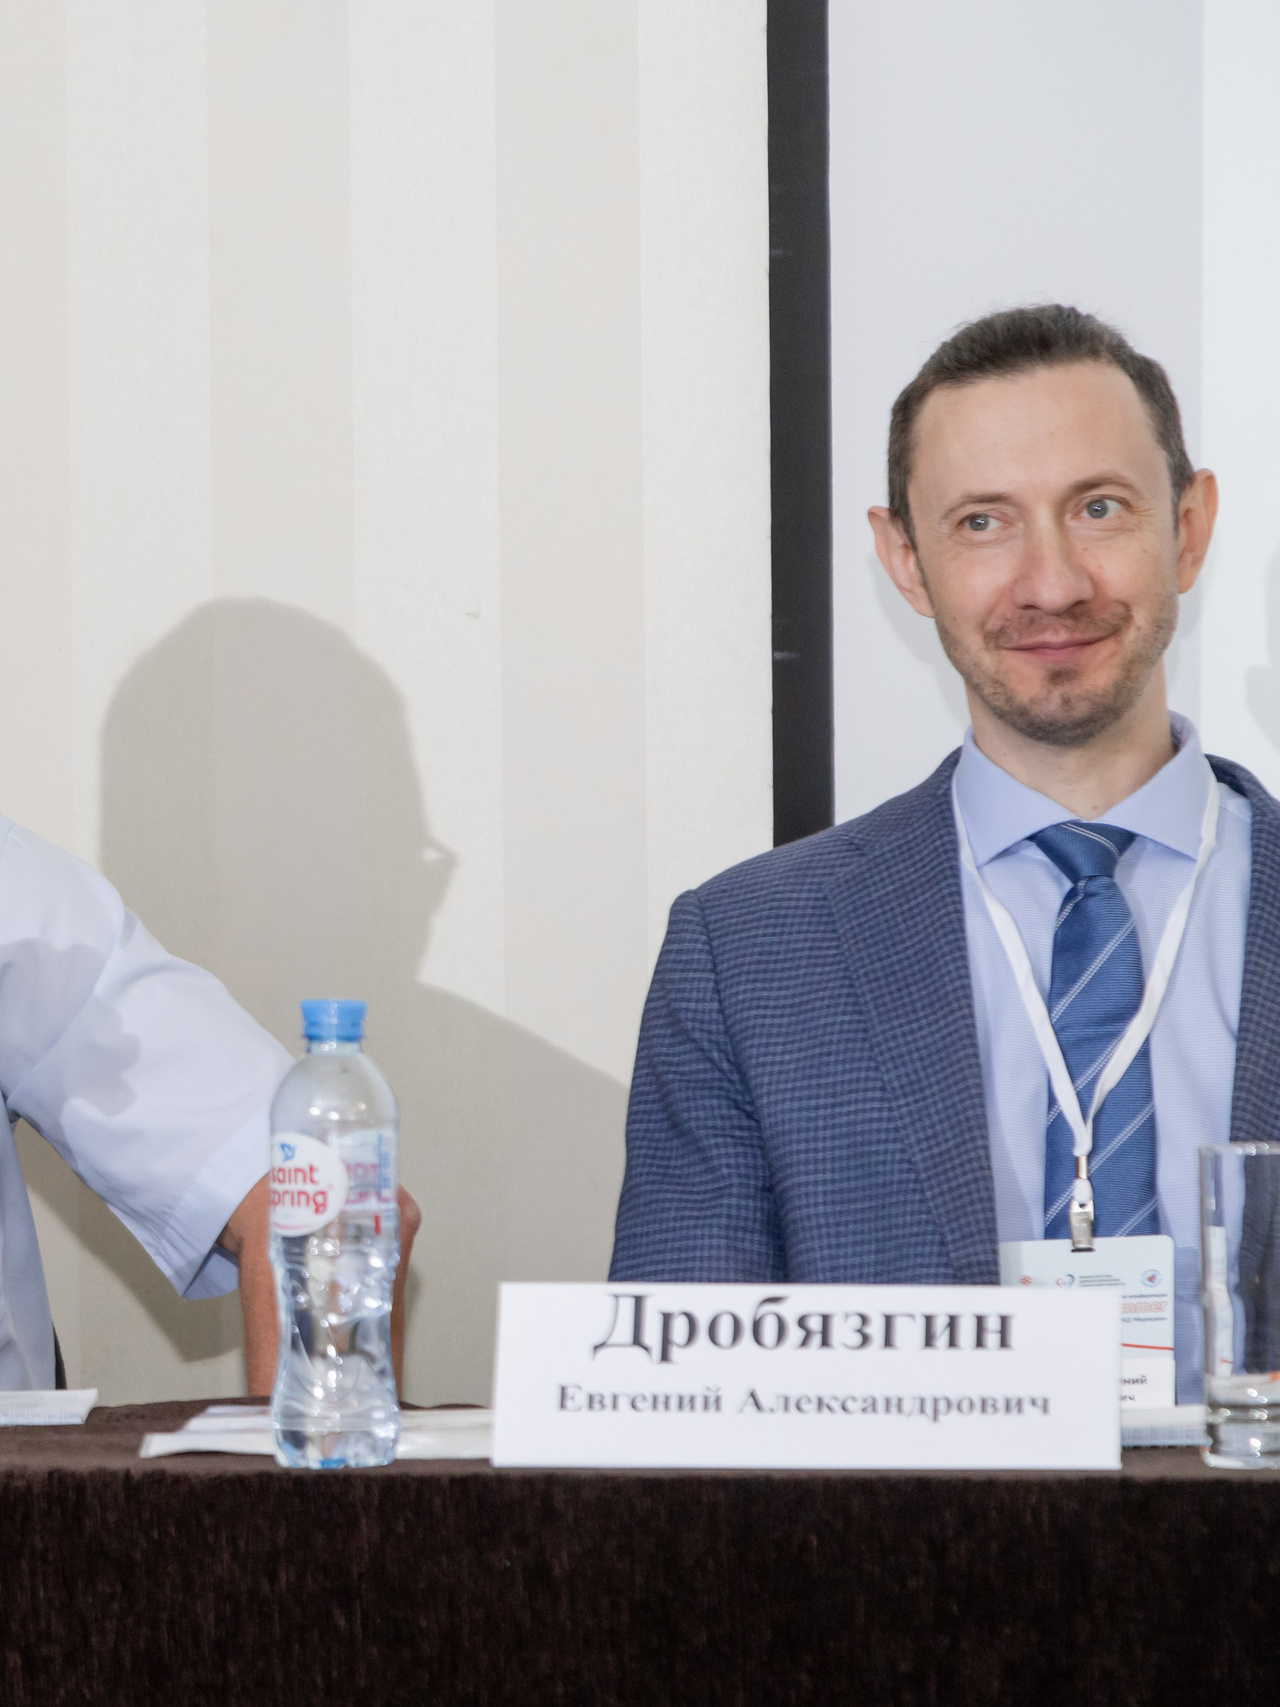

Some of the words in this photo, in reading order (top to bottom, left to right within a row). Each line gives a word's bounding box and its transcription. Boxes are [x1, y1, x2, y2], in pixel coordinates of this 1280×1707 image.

[269, 1188, 328, 1215] pring
[1121, 1301, 1168, 1314] mmer
[593, 1293, 1015, 1363] Дробязгин
[558, 1384, 723, 1413] Евгений
[738, 1386, 1052, 1423] Александрович
